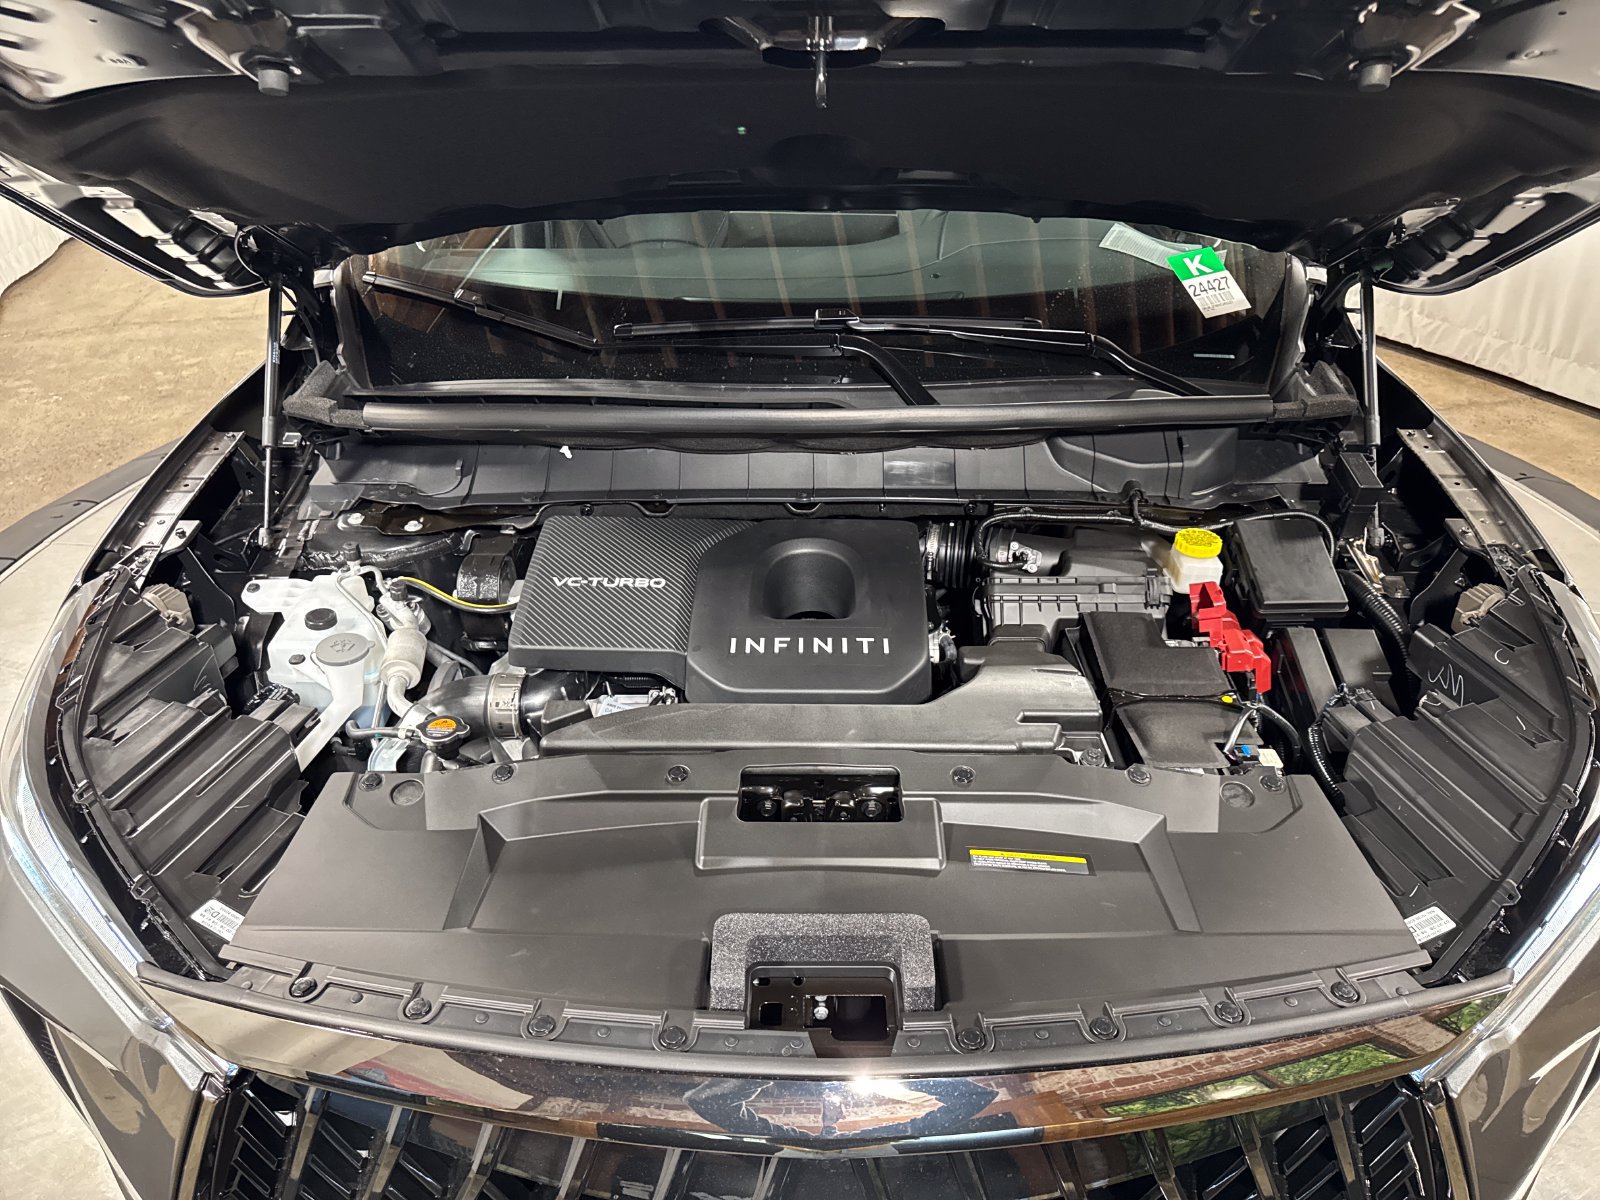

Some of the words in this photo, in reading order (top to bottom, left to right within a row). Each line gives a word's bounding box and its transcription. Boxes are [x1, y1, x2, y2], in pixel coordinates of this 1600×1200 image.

[1183, 254, 1214, 276] K
[1188, 276, 1231, 298] 24427
[552, 576, 666, 588] VC-TURBO
[729, 637, 890, 654] INFINITI
